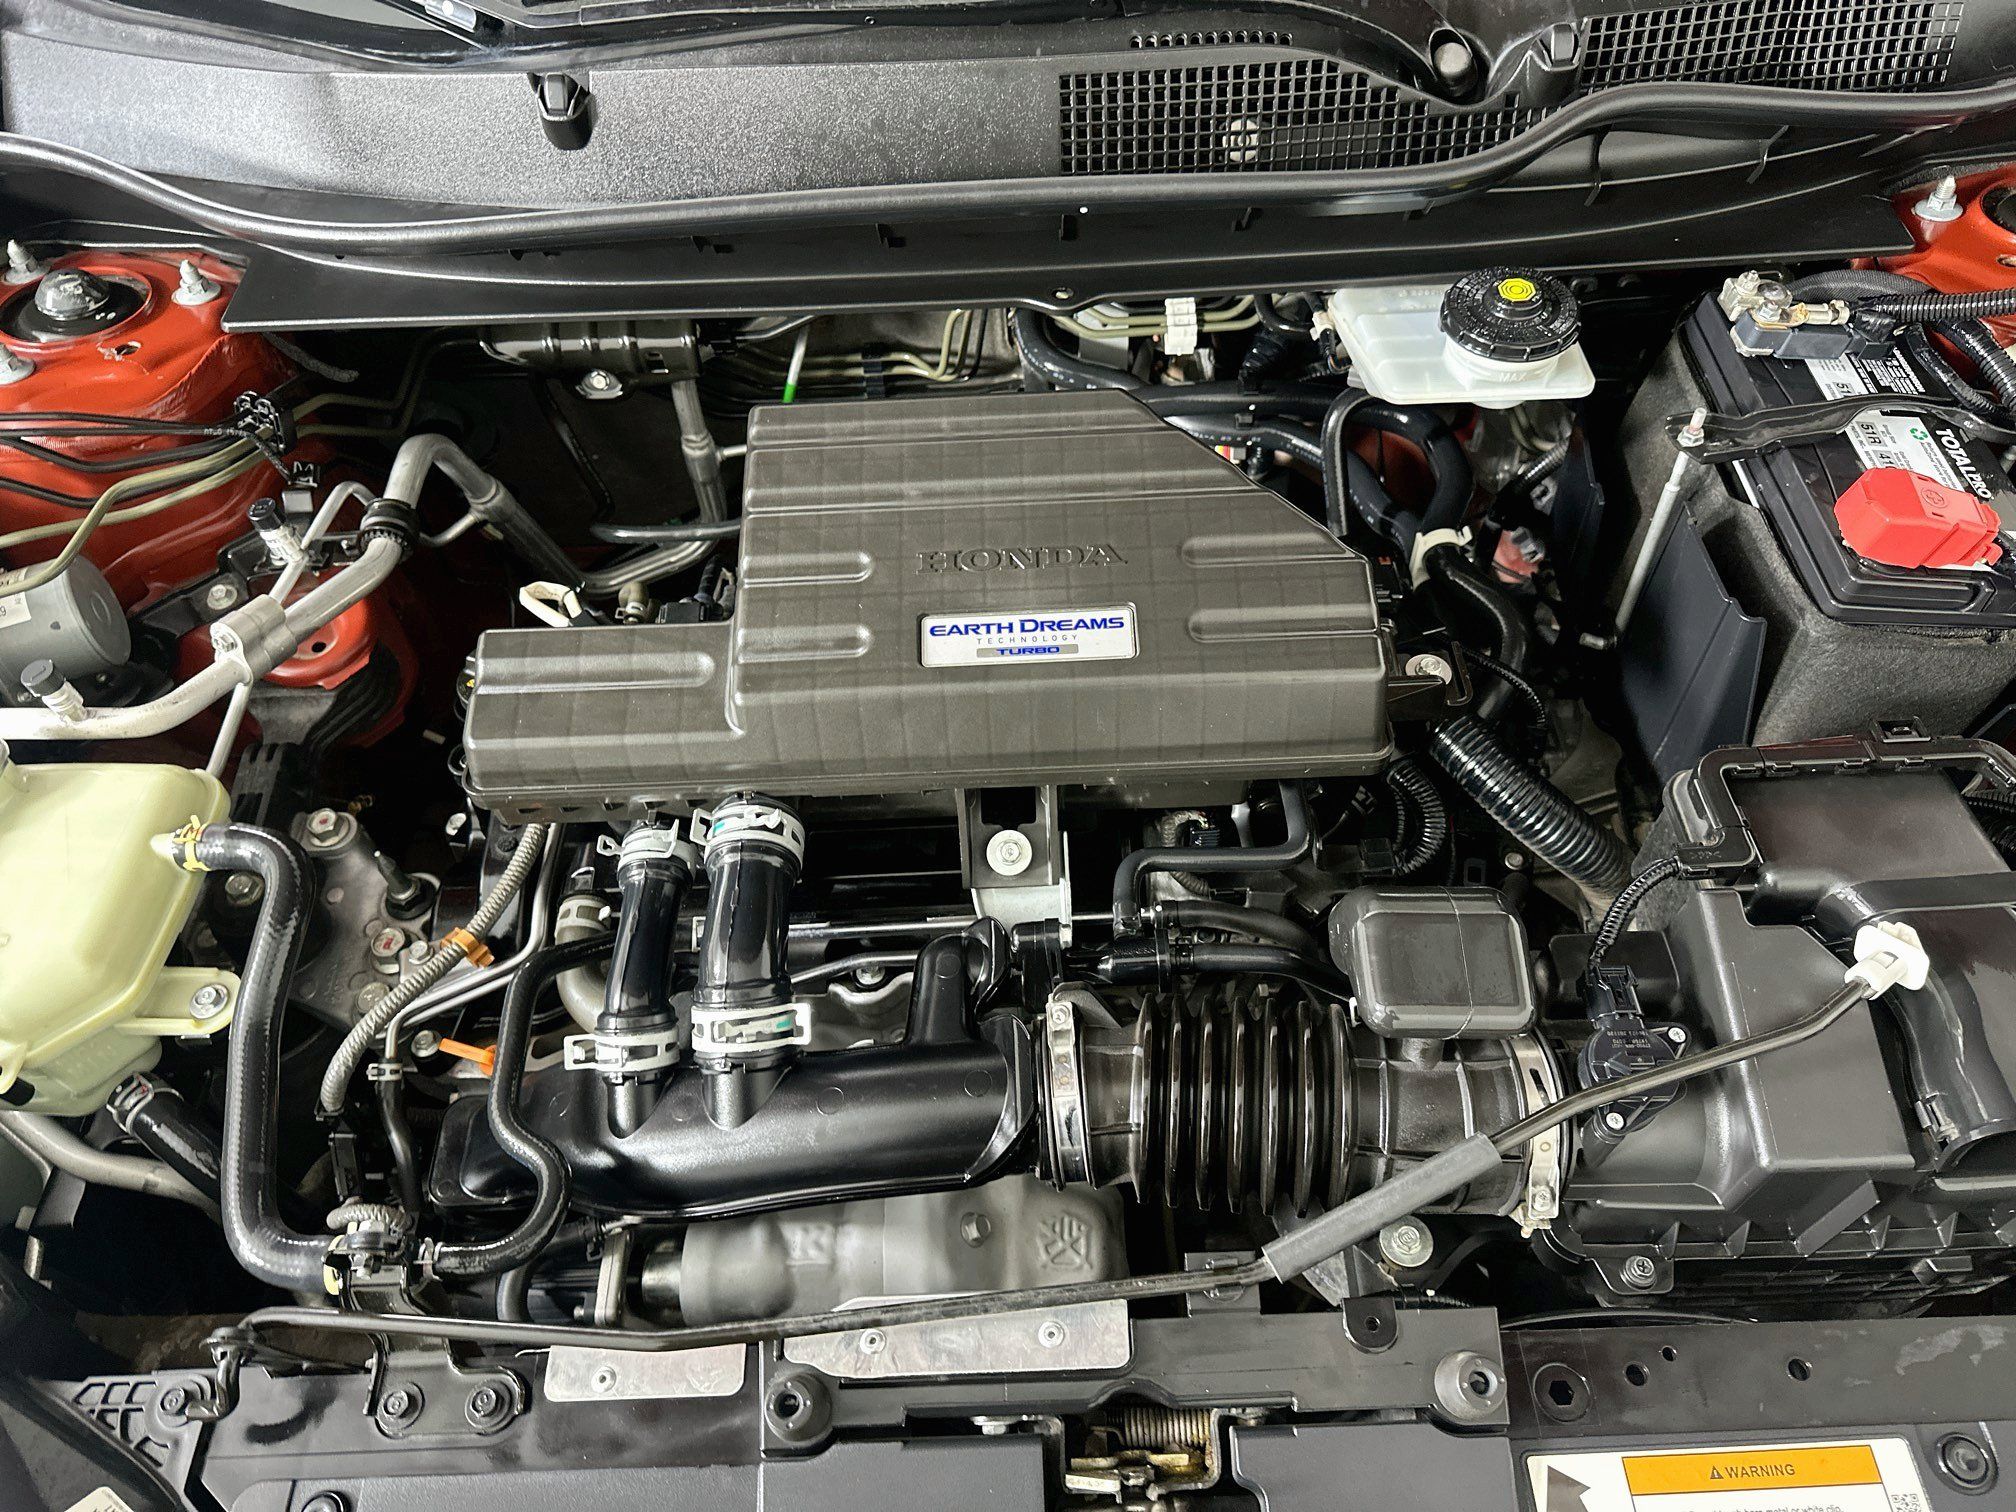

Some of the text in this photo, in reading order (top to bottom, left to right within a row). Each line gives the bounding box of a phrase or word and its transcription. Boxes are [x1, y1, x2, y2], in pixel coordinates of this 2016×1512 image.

[1861, 423, 1882, 445] 51R
[1935, 429, 1992, 498] TOTALPRO
[915, 544, 1129, 575] HONDA
[929, 617, 1125, 637] EARTH DREAMS
[977, 634, 1078, 645] TECHNOLOGY
[996, 645, 1060, 656] TURBO
[1725, 1463, 1796, 1479] WARNING
